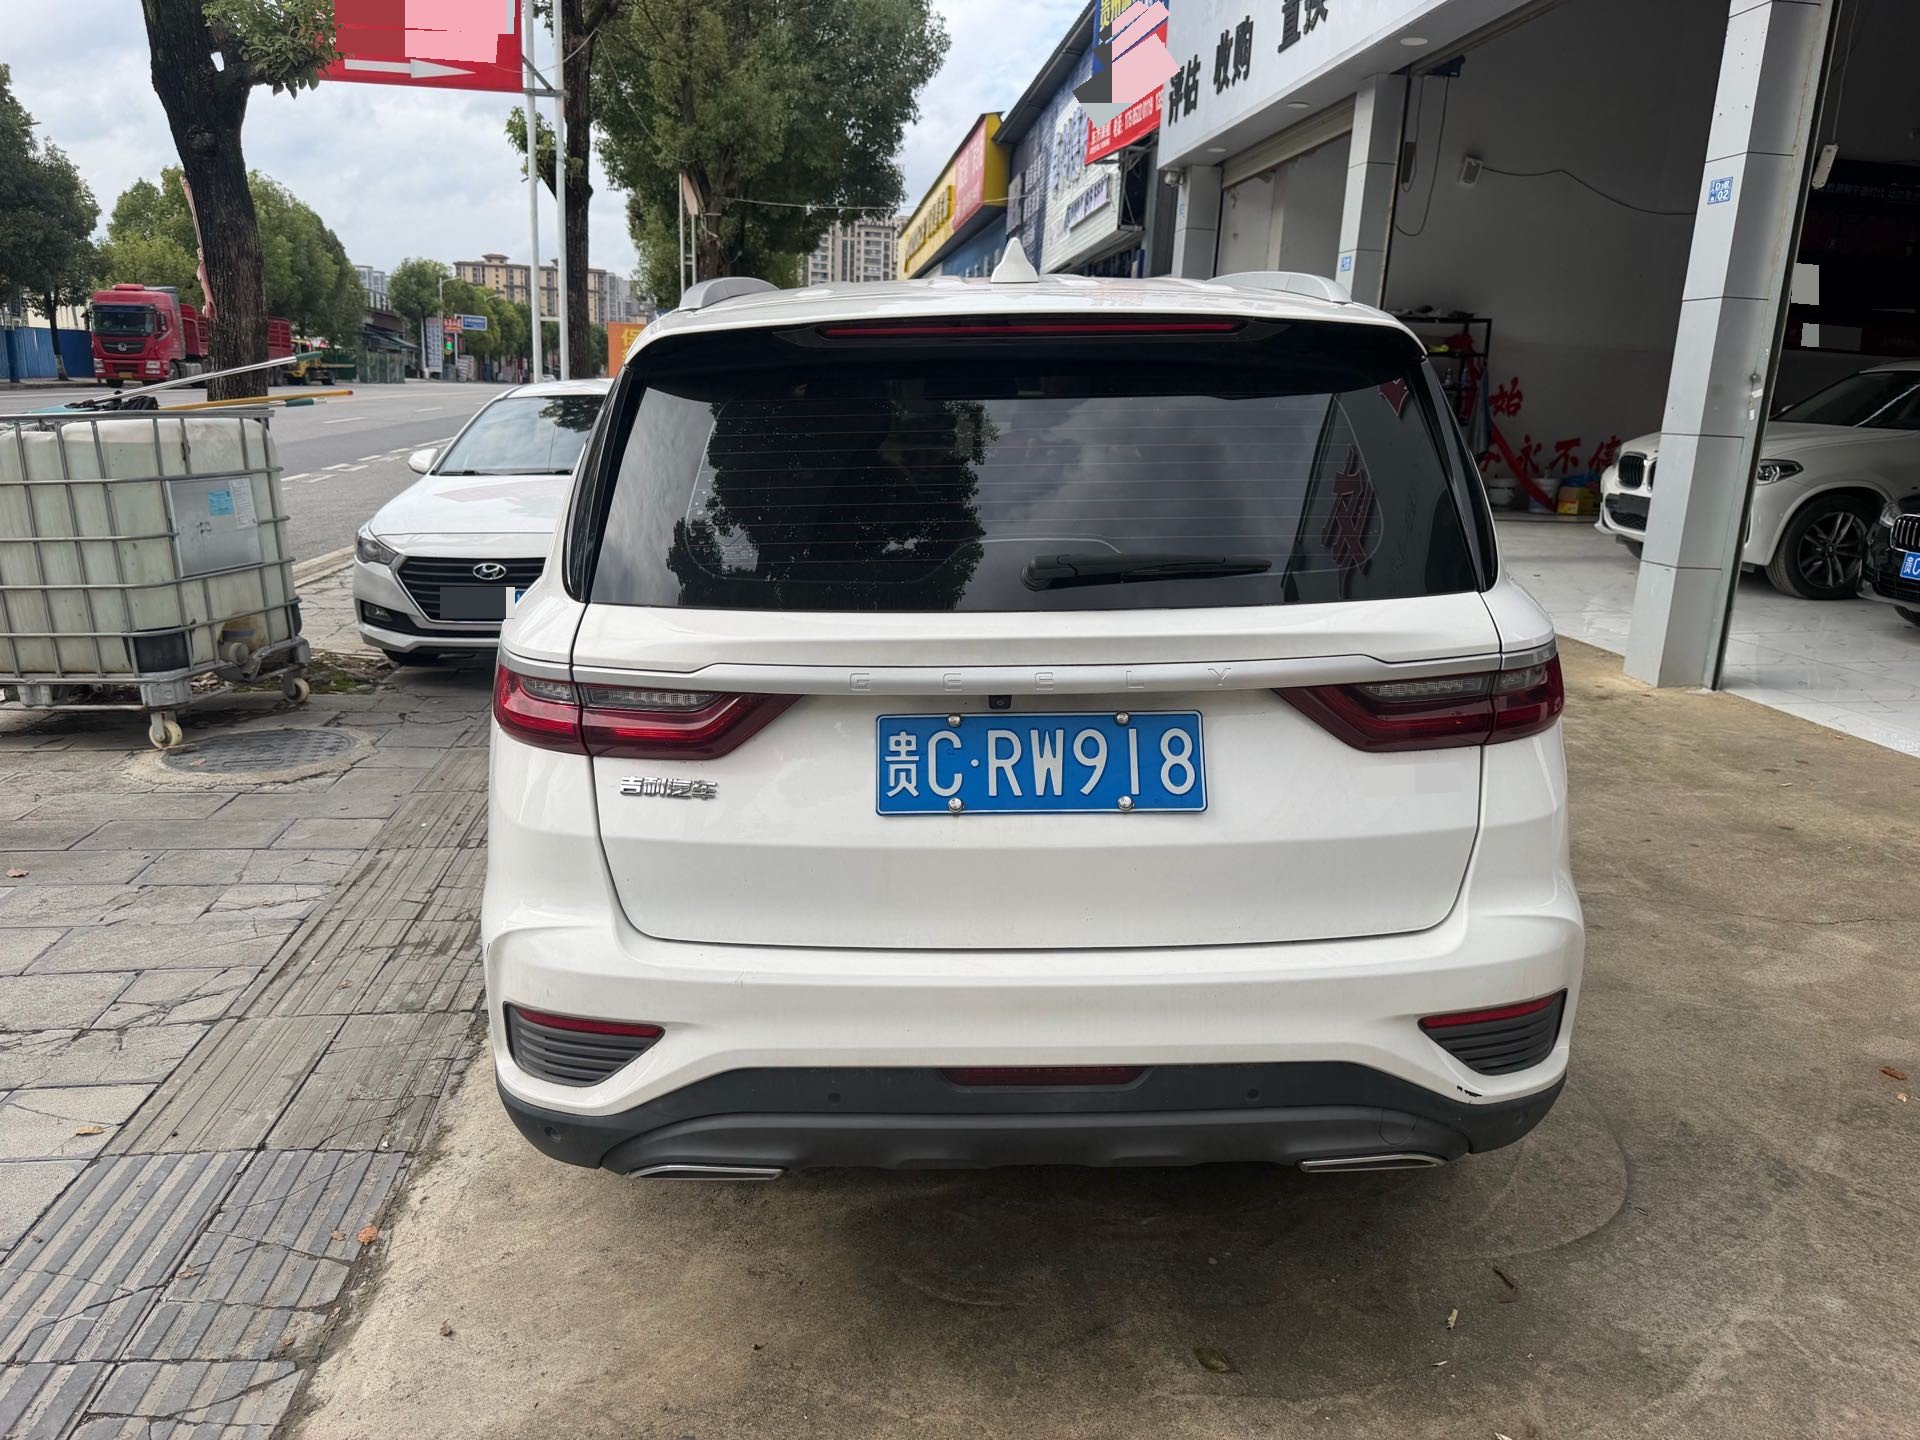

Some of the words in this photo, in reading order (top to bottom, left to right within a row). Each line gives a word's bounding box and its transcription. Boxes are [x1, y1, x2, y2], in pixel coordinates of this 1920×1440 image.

[1168, 54, 1201, 127] 评估
[1213, 15, 1254, 96] 收购
[849, 667, 1232, 692] GEELY
[620, 776, 718, 801] 吉利汽车
